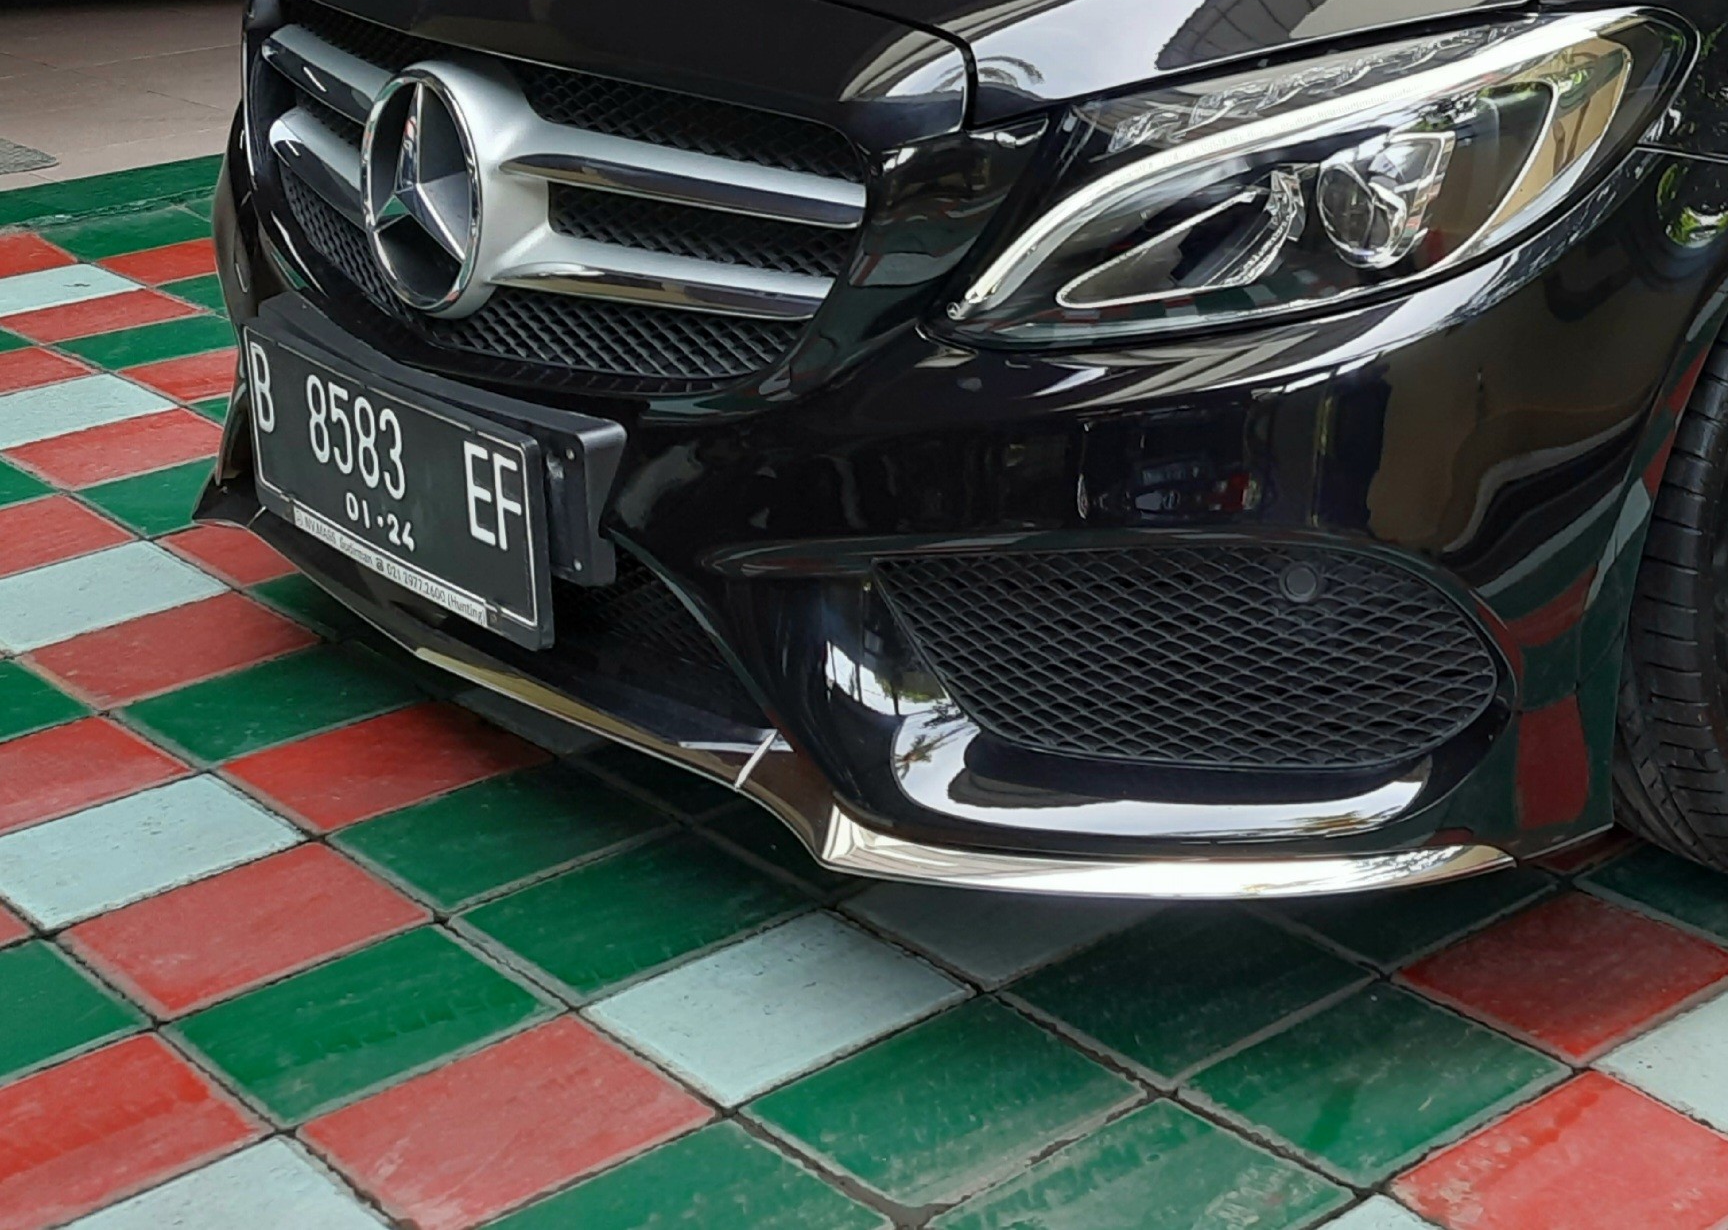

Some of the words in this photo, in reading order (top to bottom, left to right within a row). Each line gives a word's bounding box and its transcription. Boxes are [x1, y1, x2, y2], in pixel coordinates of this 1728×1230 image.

[250, 341, 275, 433] B
[306, 374, 405, 500] 8583
[463, 440, 522, 551] EF
